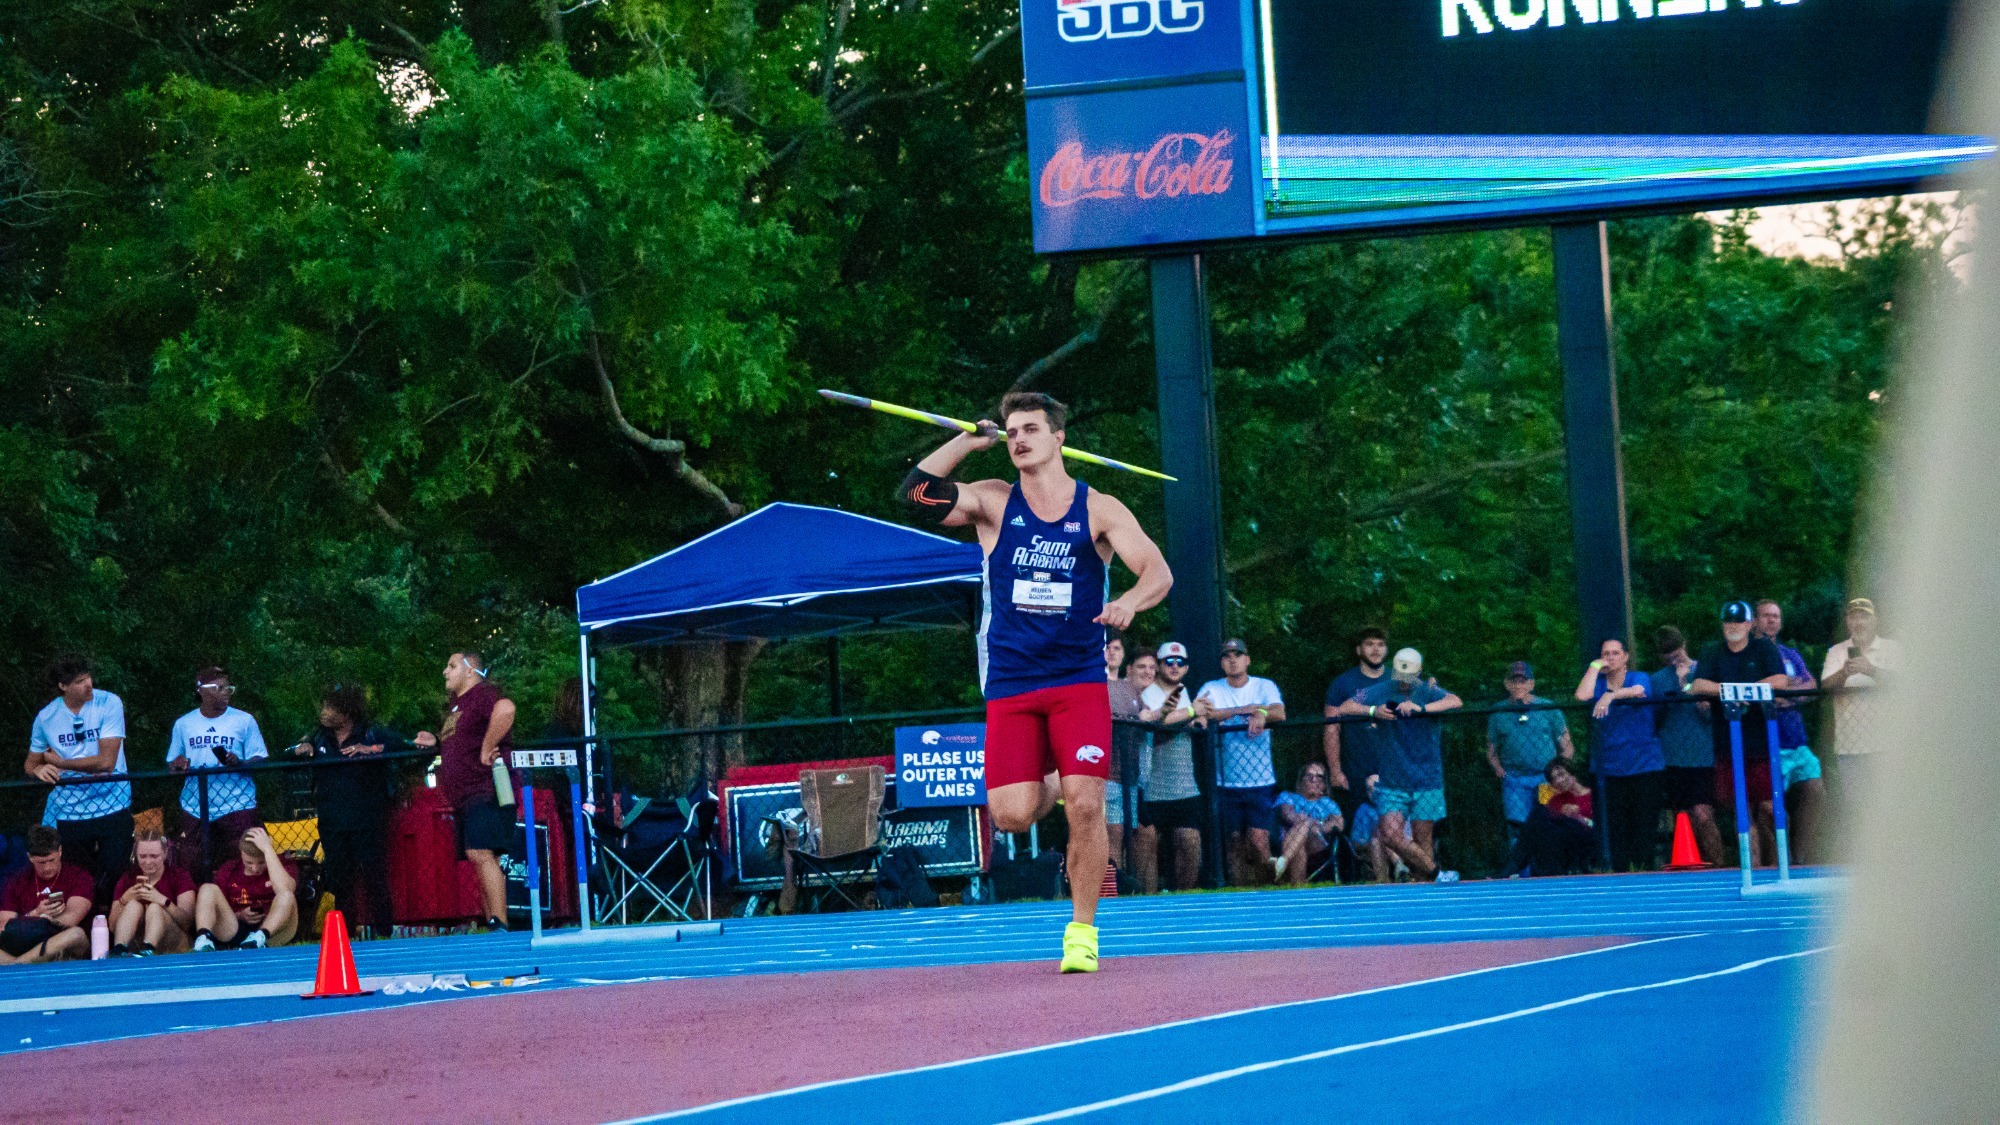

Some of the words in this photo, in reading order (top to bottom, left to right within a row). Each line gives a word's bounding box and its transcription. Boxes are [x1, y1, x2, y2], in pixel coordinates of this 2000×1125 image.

[1038, 127, 1235, 207] Coca-Cola
[1012, 546, 1077, 570] ALABAMA
[189, 735, 235, 746] BOBCAT
[902, 751, 962, 766] PLEASE
[965, 750, 985, 764] US
[902, 767, 957, 782] OUTER
[959, 766, 985, 780] TW
[925, 783, 976, 798] LANES
